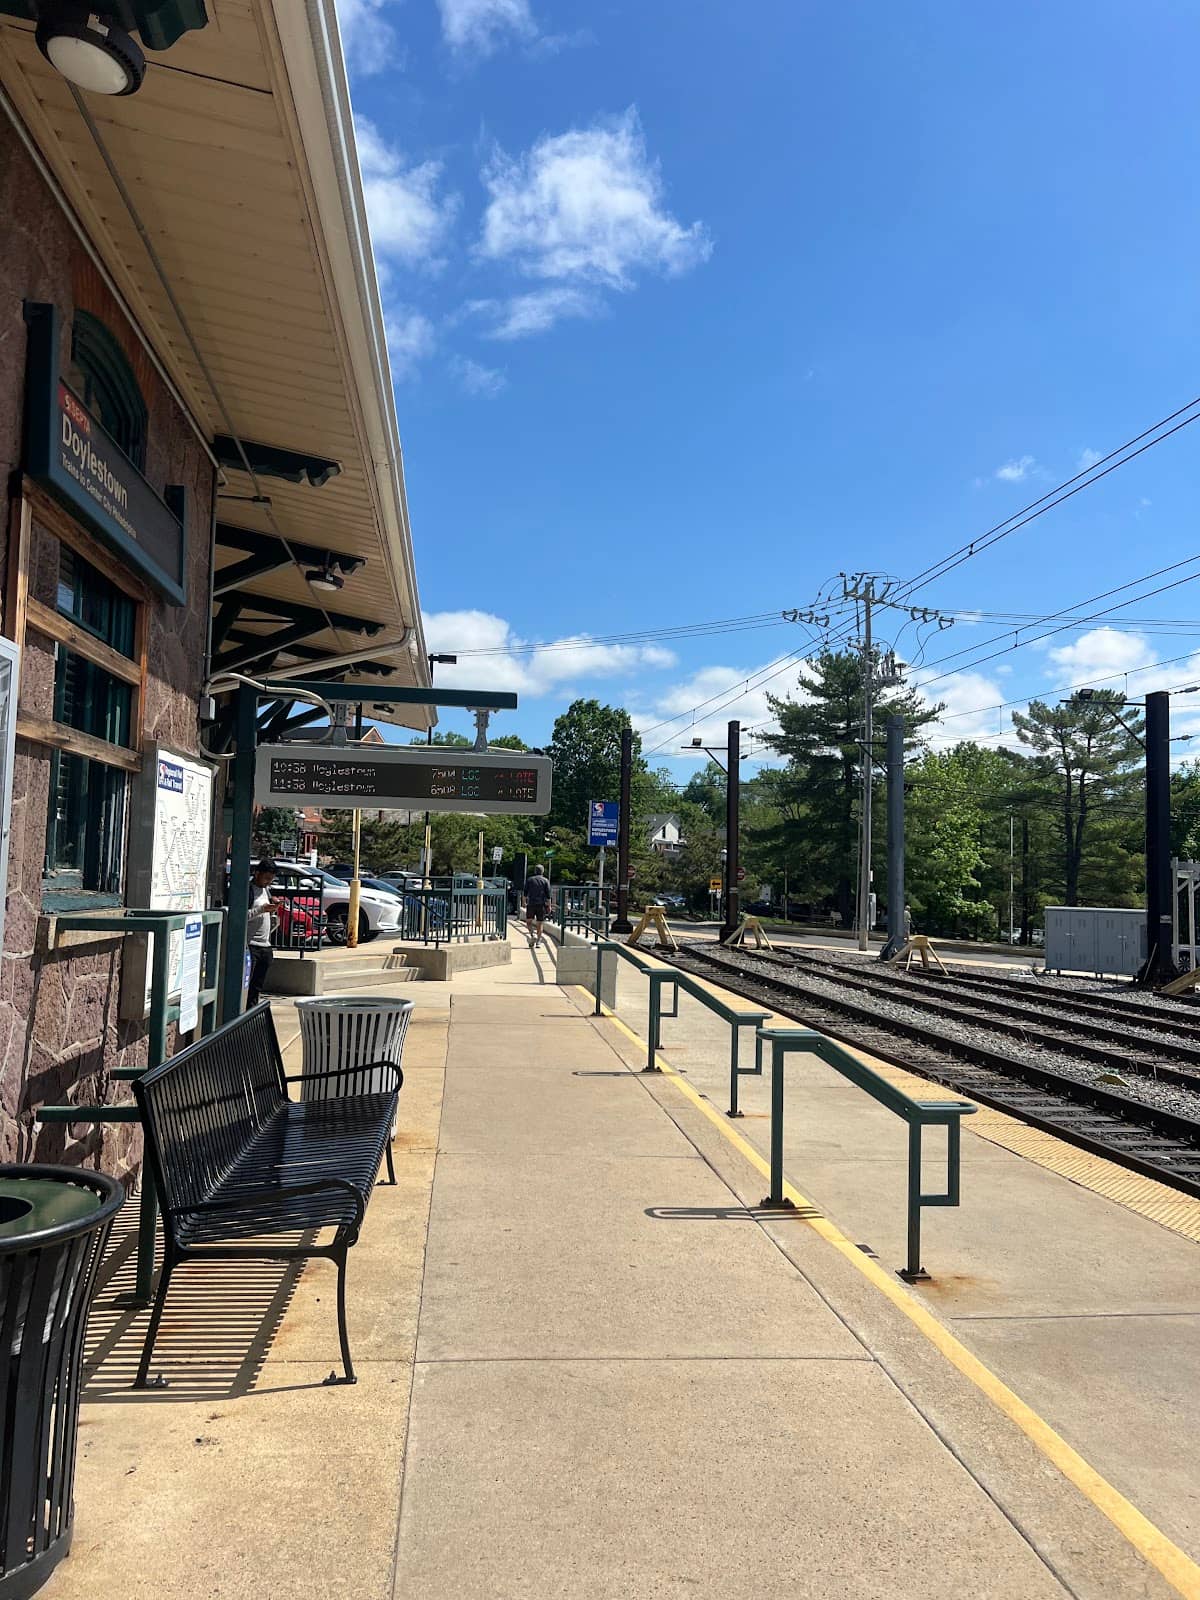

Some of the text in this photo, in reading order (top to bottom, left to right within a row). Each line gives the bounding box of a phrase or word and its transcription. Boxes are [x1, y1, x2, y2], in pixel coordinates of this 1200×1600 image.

[62, 413, 128, 510] Doylestown
[62, 452, 80, 481] Trains
[80, 472, 86, 487] to
[86, 479, 103, 504] Center
